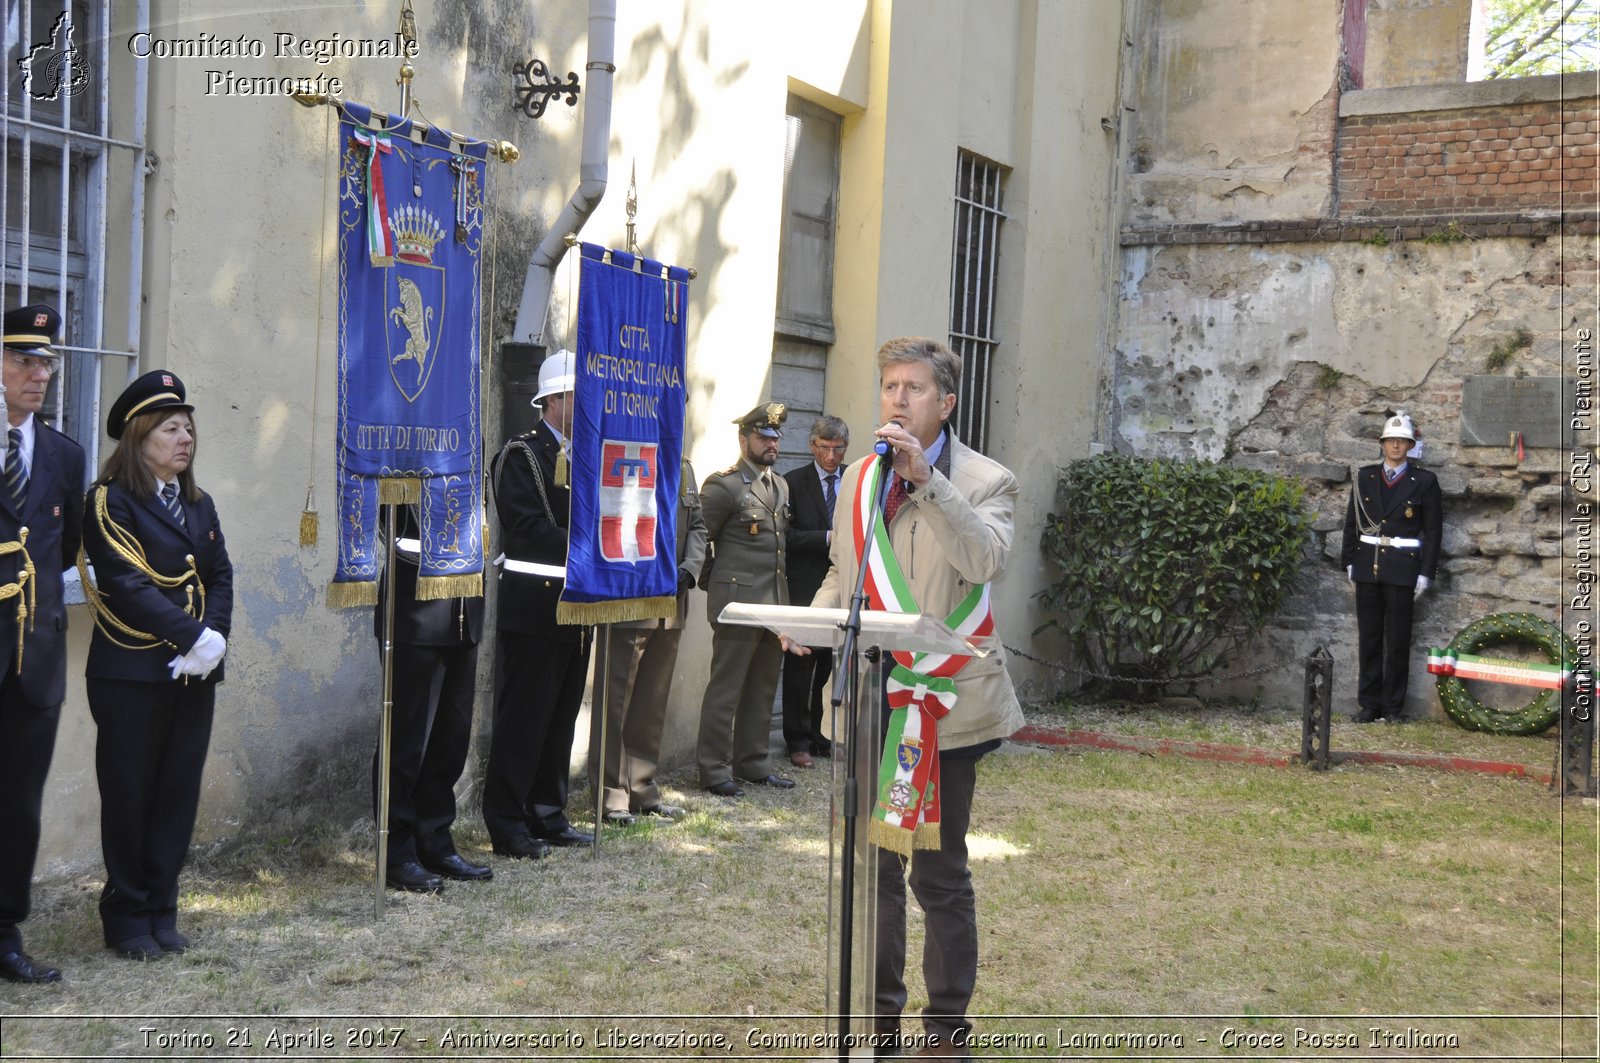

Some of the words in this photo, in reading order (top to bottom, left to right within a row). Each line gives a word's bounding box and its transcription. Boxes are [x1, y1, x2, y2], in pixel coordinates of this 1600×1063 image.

[586, 351, 682, 389] METROPOLITANA
[605, 389, 617, 415] DI
[621, 391, 659, 420] TORINO
[395, 425, 411, 450] DI
[415, 426, 460, 452] TORINO
